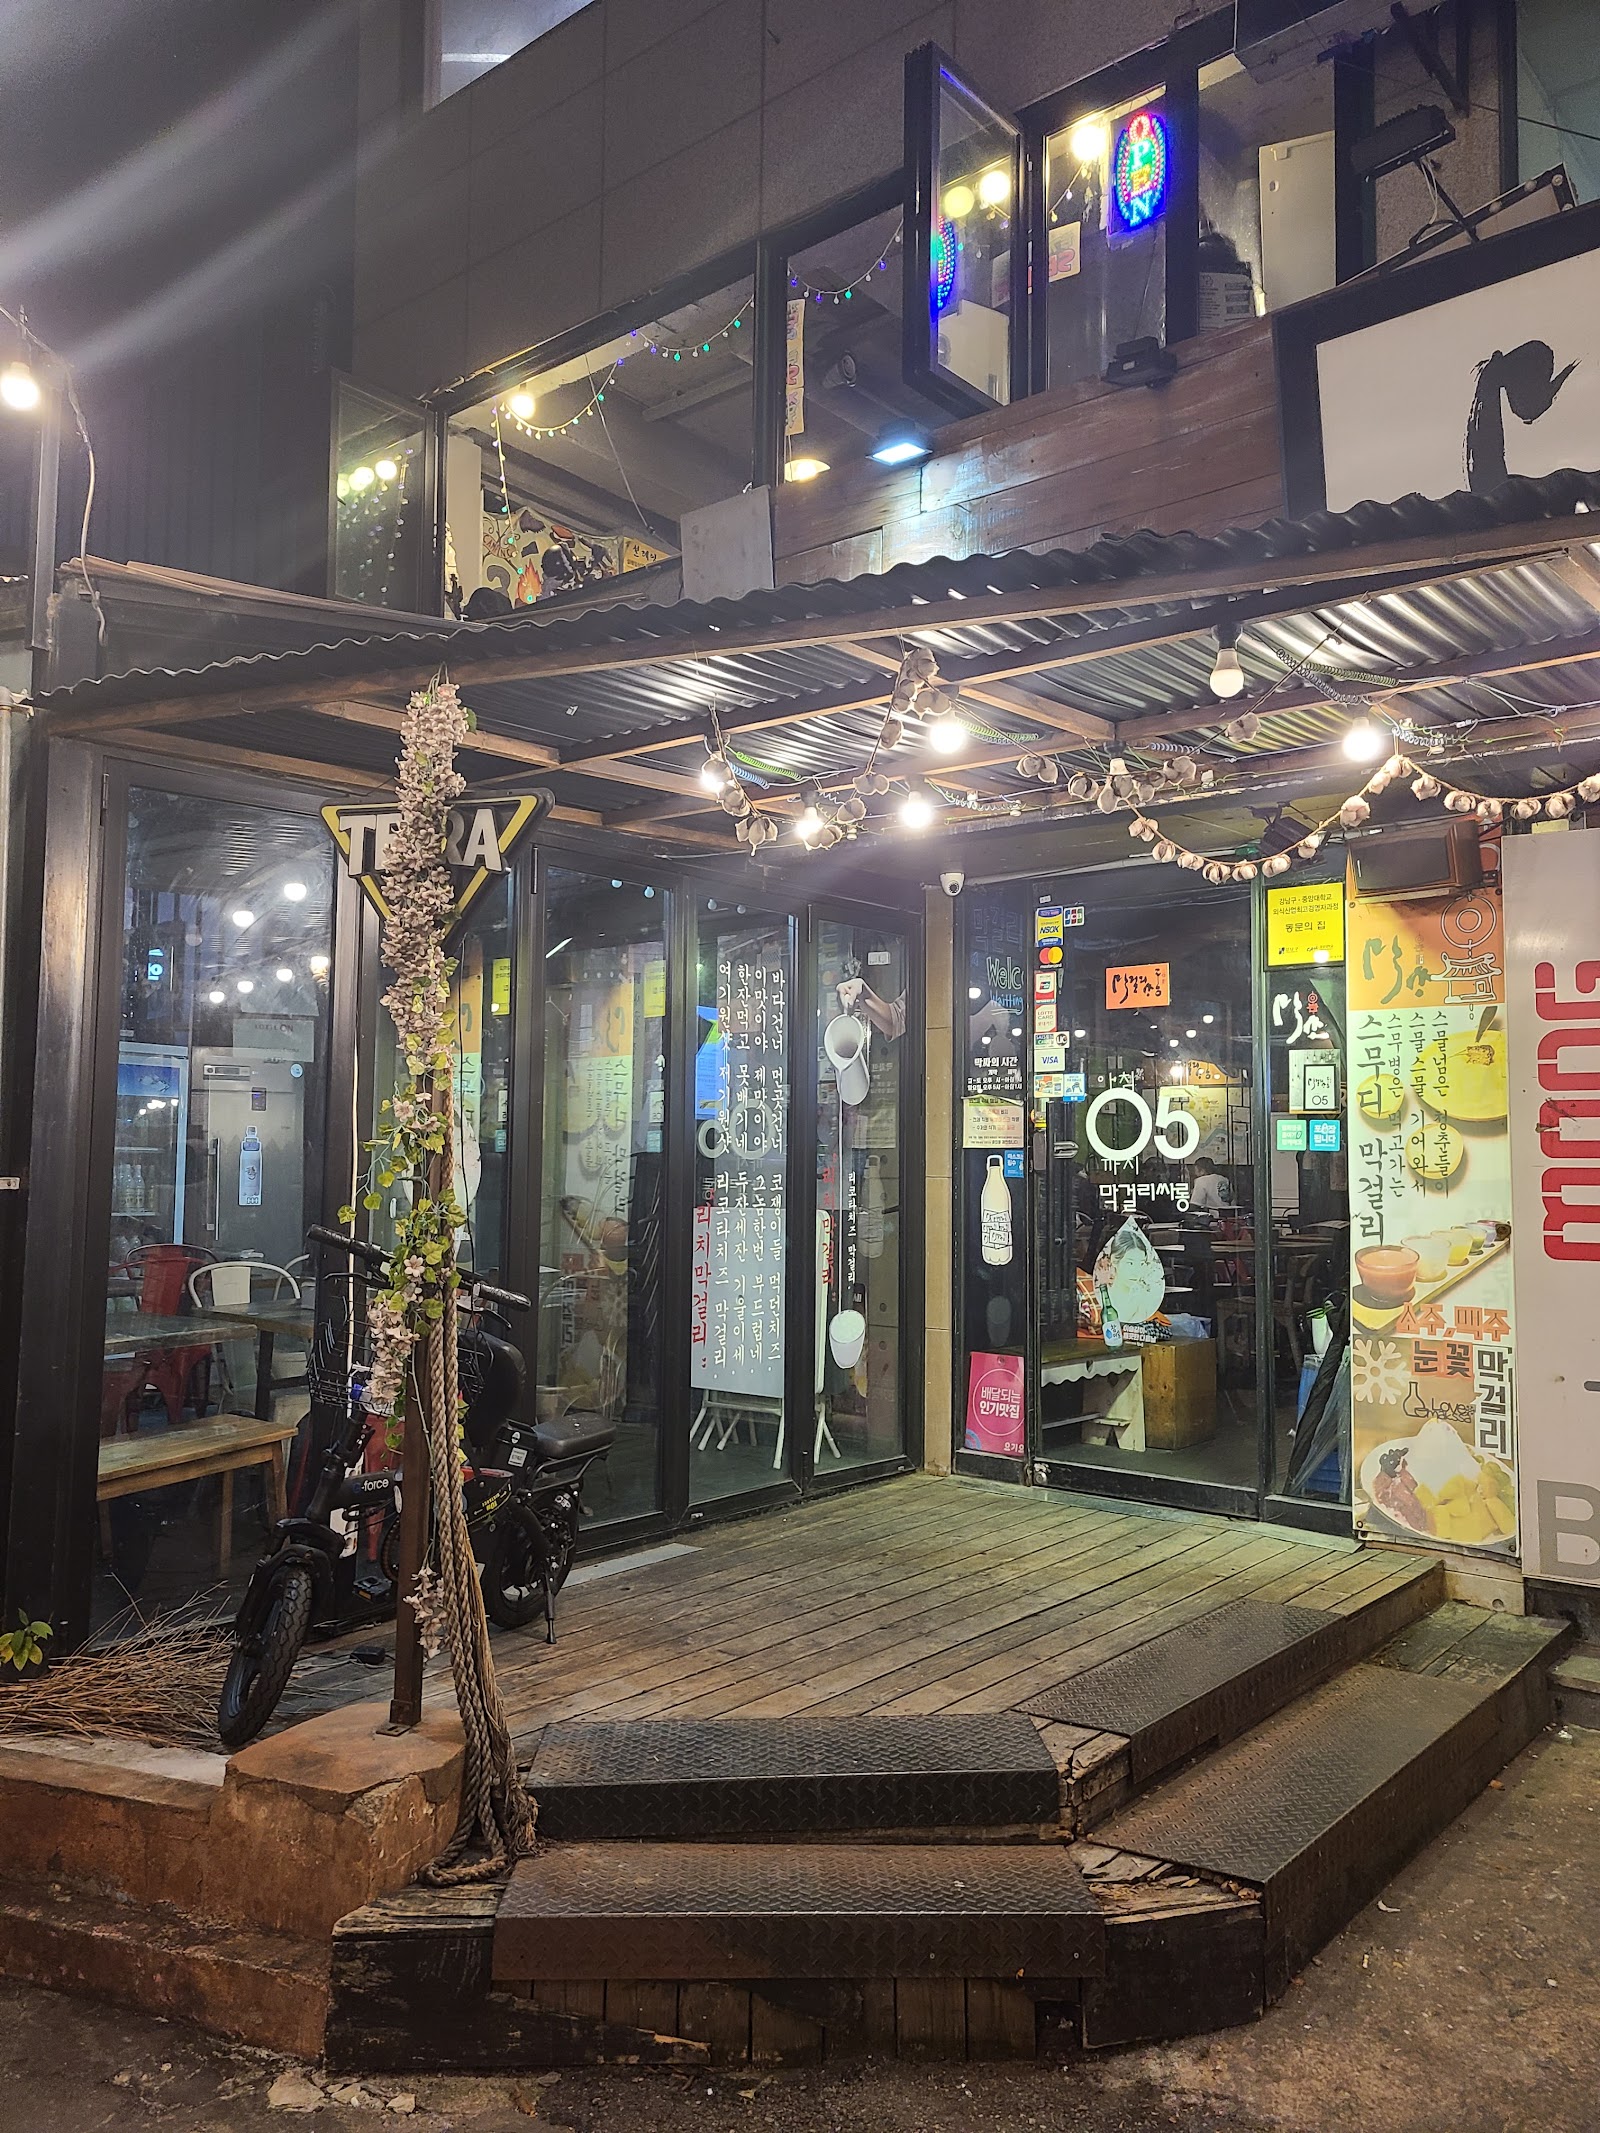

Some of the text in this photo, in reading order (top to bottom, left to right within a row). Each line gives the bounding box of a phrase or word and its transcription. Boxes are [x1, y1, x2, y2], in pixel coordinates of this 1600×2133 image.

[1128, 112, 1155, 227] OPEN
[339, 808, 502, 876] TERA
[1065, 908, 1083, 925] JCB
[1285, 920, 1326, 933] 동문의 집
[718, 961, 732, 1051] 여기원샷
[736, 964, 751, 1050] 한잔먹고
[755, 967, 768, 1054] 이맛이야
[771, 969, 785, 1055] 바다건너
[986, 956, 1024, 989] Welc
[1001, 1056, 1018, 1067] 시간
[1041, 1056, 1059, 1064] VISA
[717, 1063, 732, 1154] 저기원샷
[735, 1064, 750, 1153] 못배기네
[753, 1066, 767, 1154] 제맛이야
[771, 1067, 784, 1155] 먼곳건너
[1357, 1014, 1388, 1246] 스무디 막걸리
[1387, 1013, 1405, 1198] 스무병은 먹고가는
[1409, 1012, 1429, 1198] 스물스물 기어와서
[1432, 1010, 1451, 1199] 스물넘은 청춘들이
[715, 1171, 730, 1284] 리코타치즈
[734, 1171, 748, 1262] 두잔세잔
[769, 1174, 783, 1261] 코쟁이들
[847, 1170, 858, 1237] 리코타치즈
[1099, 1182, 1191, 1213] 막걸리싸롱
[981, 1386, 1021, 1404] 배달되는
[1413, 1340, 1472, 1378] 눈꽃
[1477, 1349, 1511, 1456] 막걸리
[979, 1400, 1020, 1419] 인기맛집
[1431, 1397, 1466, 1416] Love
